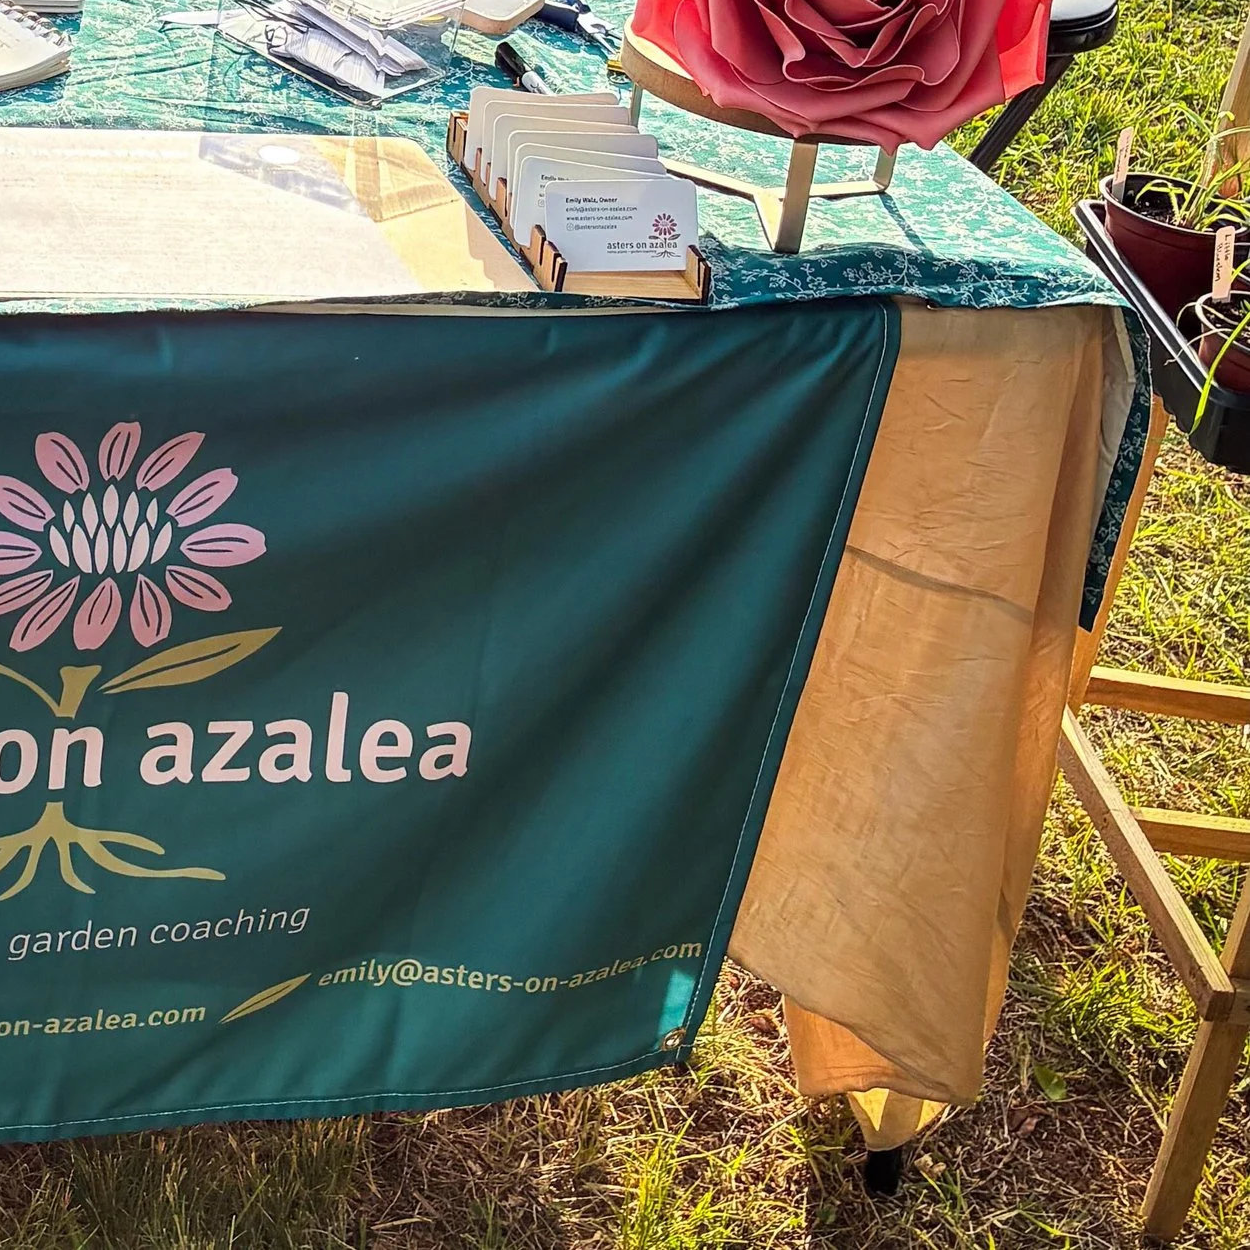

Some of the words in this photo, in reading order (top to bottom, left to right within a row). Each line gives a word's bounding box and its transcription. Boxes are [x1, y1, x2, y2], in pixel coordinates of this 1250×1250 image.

[649, 239, 678, 249] azalea
[1224, 234, 1233, 261] Little
[139, 691, 472, 786] azalea
[8, 919, 138, 961] garden
[149, 906, 310, 946] coaching
[317, 940, 702, 994] emily@asters-on-azalea.com
